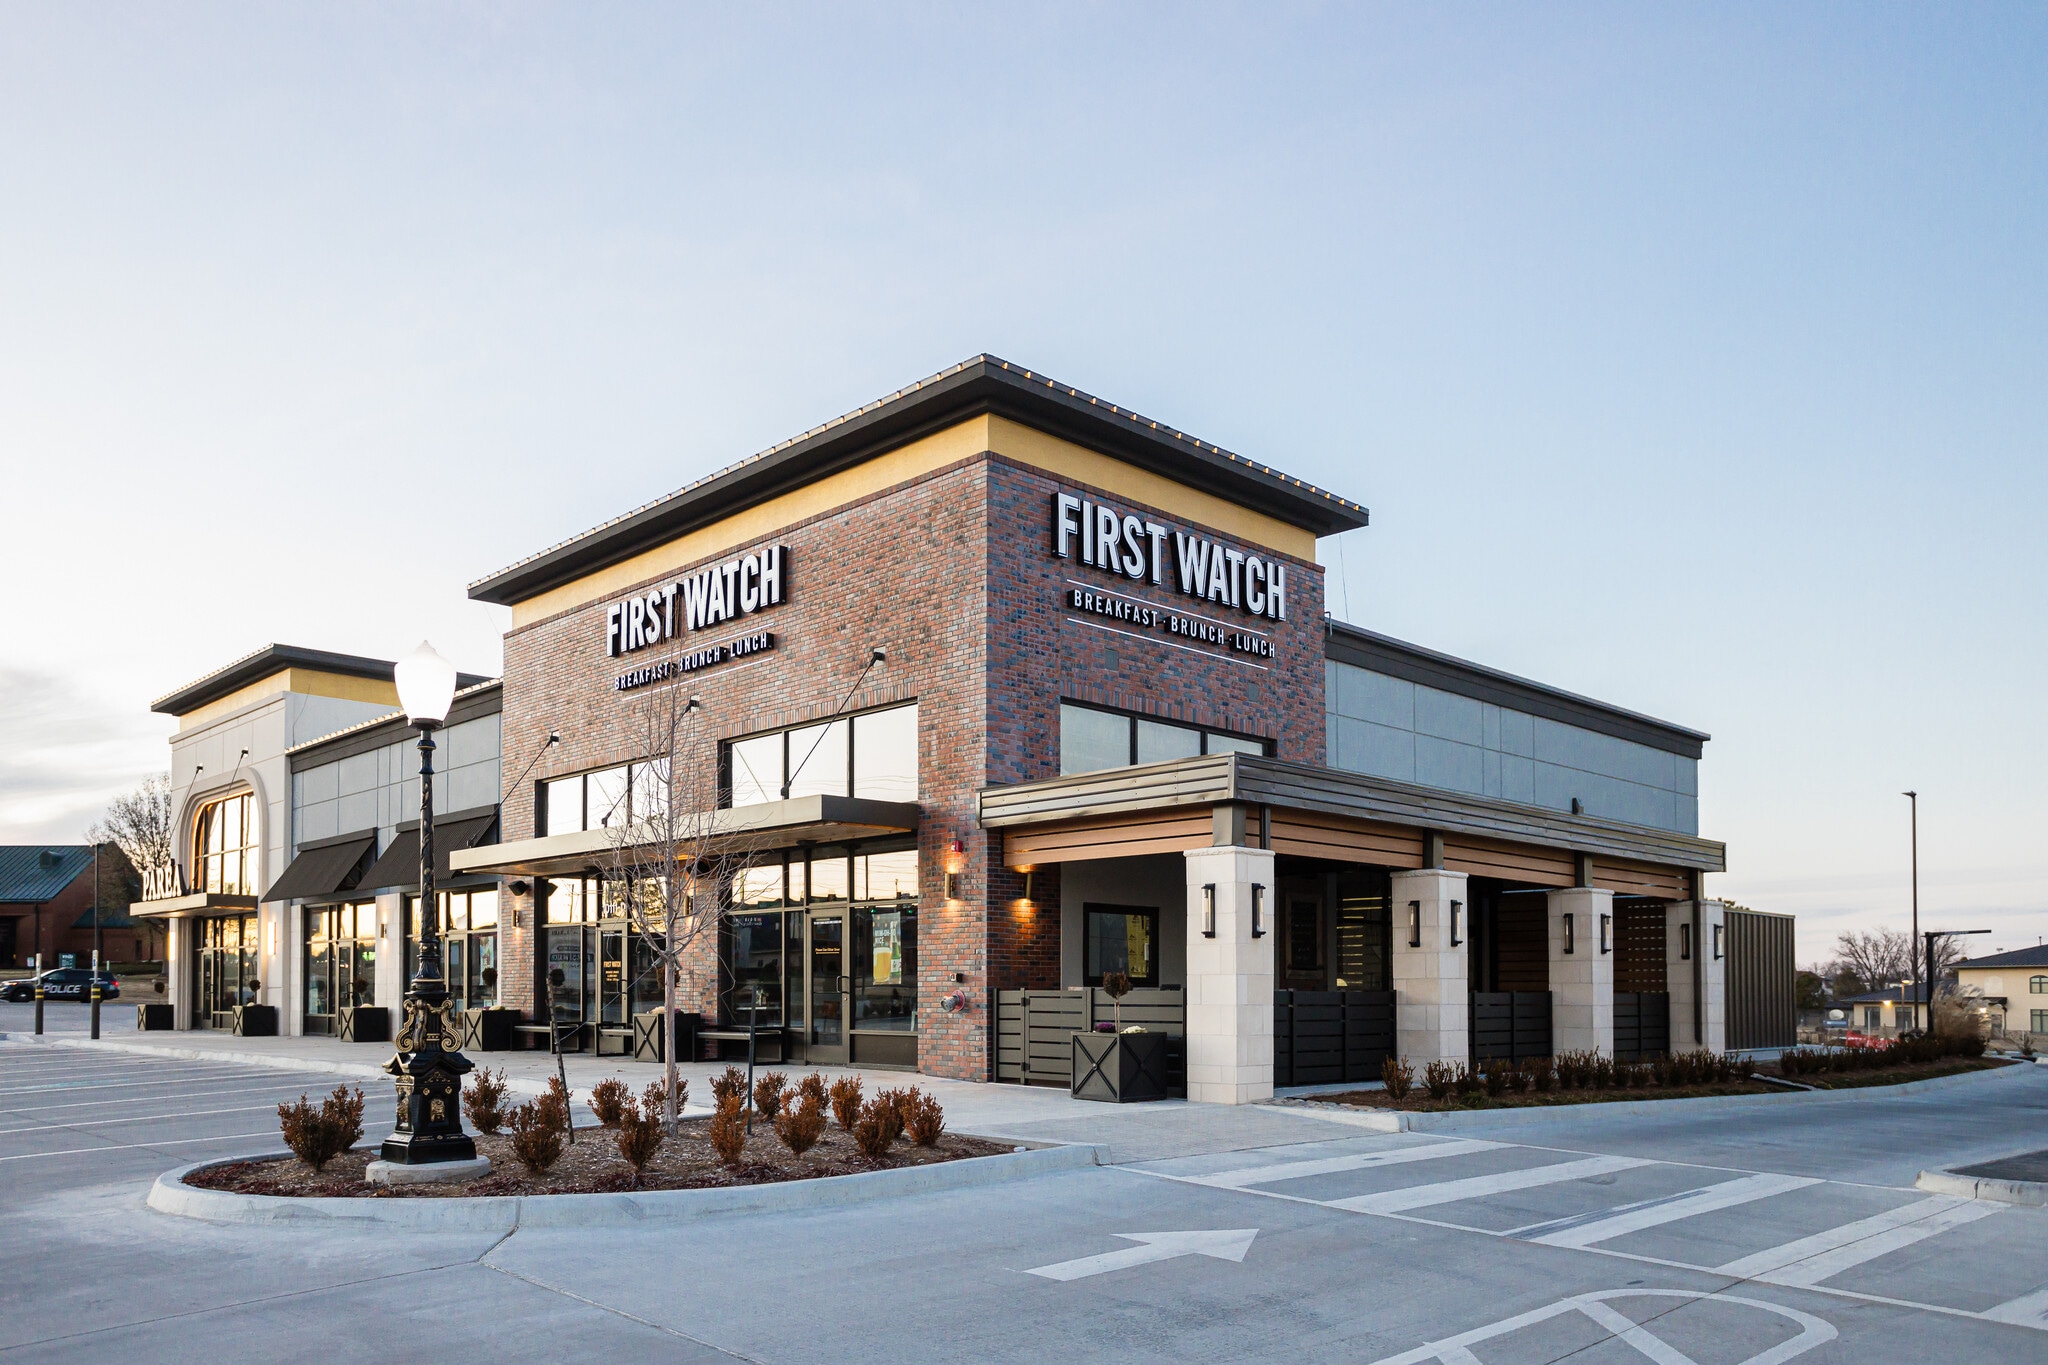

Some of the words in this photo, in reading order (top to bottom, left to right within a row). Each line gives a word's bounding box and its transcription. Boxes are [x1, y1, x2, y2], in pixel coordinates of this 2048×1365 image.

[1054, 491, 1168, 586] FIRST
[1172, 531, 1287, 622] WATCH
[606, 583, 680, 657] FIRST
[683, 545, 786, 631] WATCH
[1073, 589, 1158, 627] BREAKFAST
[1170, 616, 1225, 646] BRUNCH
[1235, 634, 1276, 659] LUNCH
[614, 661, 671, 691] BREAKFAST
[678, 646, 721, 672] BRUNCH
[730, 632, 768, 657] LUNCH
[43, 984, 82, 994] POLICE
